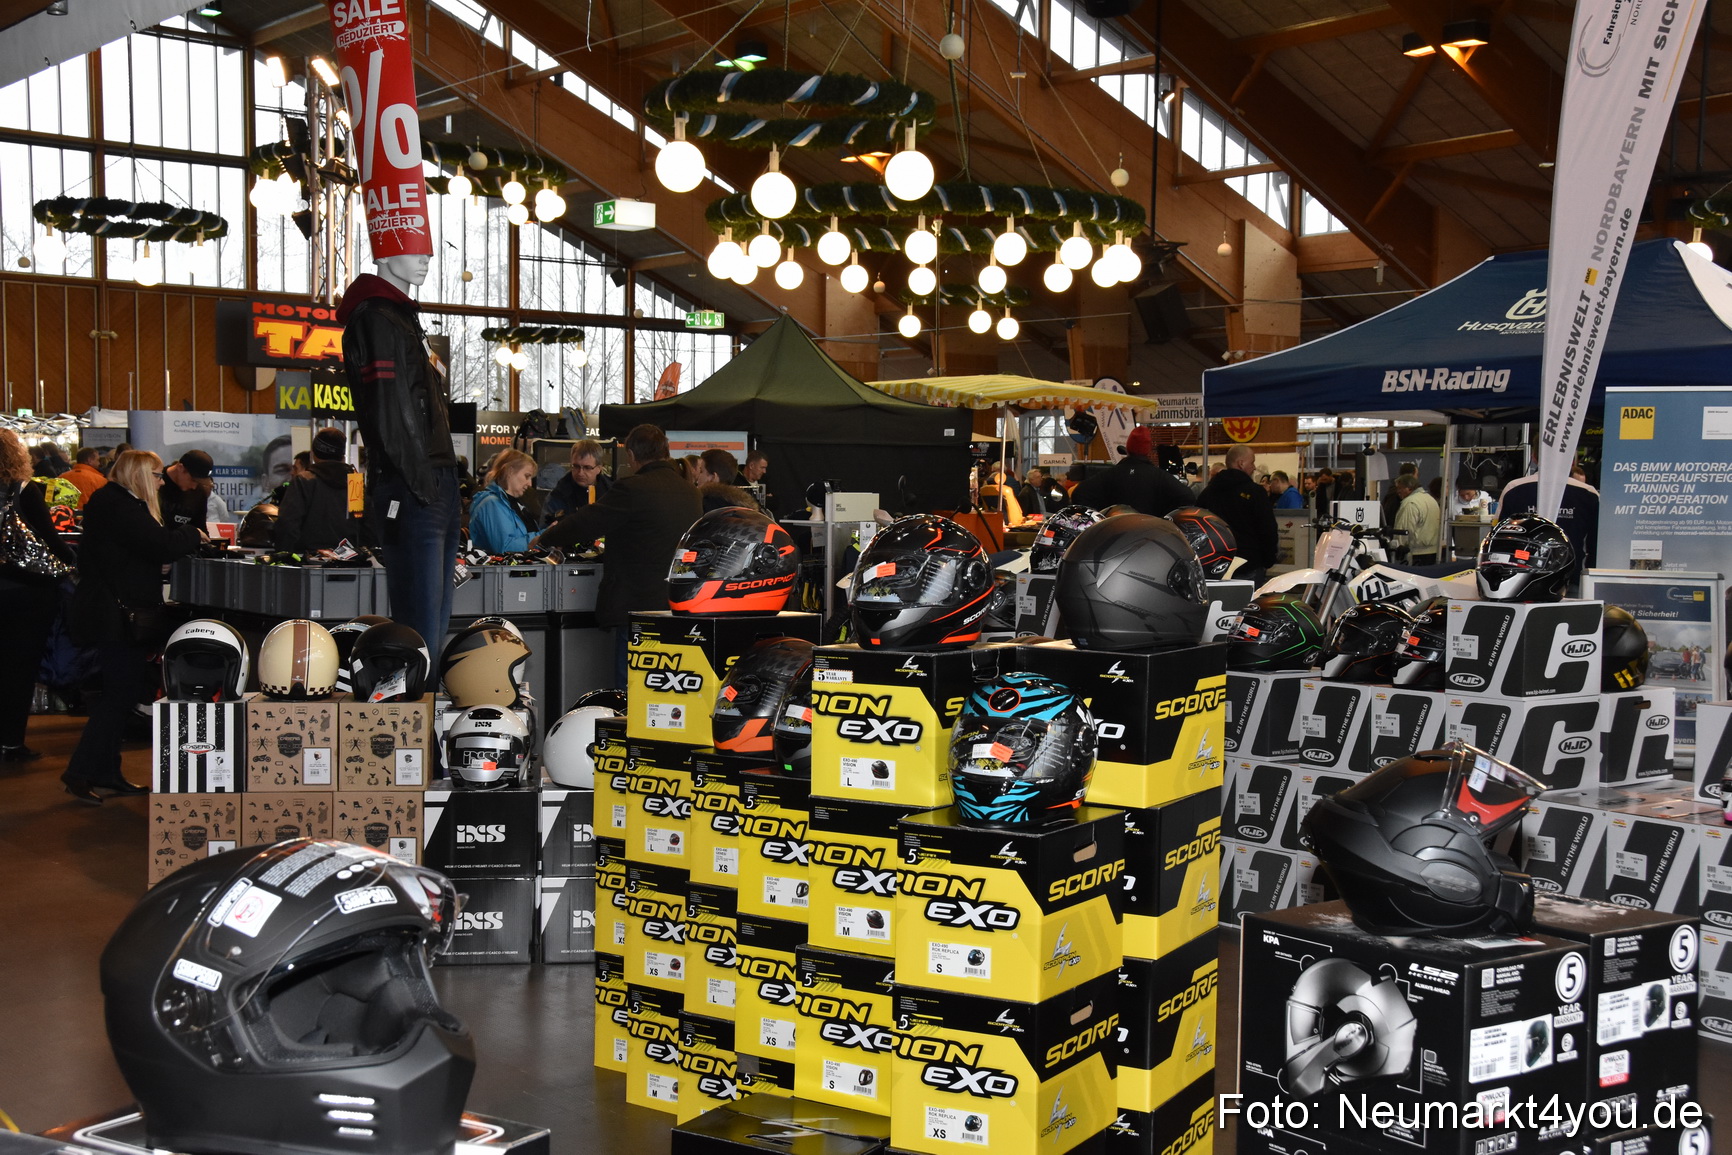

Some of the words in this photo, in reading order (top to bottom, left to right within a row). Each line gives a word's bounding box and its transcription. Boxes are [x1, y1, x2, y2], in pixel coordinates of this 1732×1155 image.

[333, 0, 401, 28] SALE
[338, 22, 397, 45] REDUZIERT
[1542, 290, 1592, 448] ERLEBNISWELT
[1591, 106, 1647, 262] NORDBAYERN
[1637, 57, 1660, 99] MIT
[252, 302, 337, 321] MOTO
[1559, 207, 1632, 454] www.erlebniswelt-bayern.de
[1381, 366, 1511, 393] BSN-Racing
[1157, 397, 1199, 406] Neumarkter
[1622, 408, 1654, 419] ADAC
[173, 420, 201, 428] CARE
[203, 421, 240, 429] VISION
[490, 425, 510, 434] FOR
[233, 468, 249, 476] SEHEN
[1613, 462, 1638, 472] DAS
[1640, 462, 1672, 472] BMW
[1624, 484, 1679, 493] TRAINING
[1682, 484, 1695, 493] IN
[1641, 495, 1728, 504] KOOPERATION
[1615, 505, 1636, 515] MIT
[1639, 505, 1667, 515] DEM
[1669, 505, 1703, 515] ADAC
[724, 572, 797, 591] SCORPIO
[1637, 610, 1679, 618] Sicherheit!
[185, 627, 215, 635] Caberg
[1493, 637, 1501, 651] THE
[1498, 614, 1510, 638] WORLD
[633, 634, 639, 645] 5
[1566, 644, 1591, 654] HJC
[646, 671, 701, 691] EXO
[818, 671, 825, 681] 5
[1455, 675, 1480, 685] HJC
[651, 719, 656, 727] S
[1494, 713, 1507, 734] WORLD
[1648, 717, 1667, 727] HJC
[840, 718, 920, 742] EXO
[601, 739, 607, 750] 5
[1563, 740, 1586, 751] HJC
[1306, 752, 1331, 761] HJC
[629, 758, 635, 769] 5
[696, 775, 703, 786] 5
[846, 777, 853, 787] L
[746, 795, 754, 808] 5
[1242, 826, 1263, 837] HJC
[1567, 842, 1577, 858] THE
[1573, 815, 1588, 844] WORLD
[907, 848, 917, 863] 5
[1656, 857, 1667, 874] THE
[1662, 828, 1678, 859] WORLD
[718, 864, 729, 873] XS
[630, 881, 636, 892] 5
[769, 894, 776, 904] M
[1613, 898, 1646, 909] HJC
[688, 905, 695, 917] 5
[927, 900, 1017, 928] EXO
[644, 921, 685, 942] EX
[842, 927, 850, 936] M
[1263, 935, 1280, 946] KPA
[1679, 935, 1689, 962] 5
[649, 967, 659, 976] XS
[936, 963, 943, 973] S
[1409, 963, 1459, 979] LS2
[601, 971, 607, 981] 5
[804, 973, 812, 986] 5
[1565, 963, 1577, 992] 5
[1671, 973, 1693, 984] YEAR
[1414, 982, 1434, 992] ALWAYS
[1432, 986, 1450, 995] AHEAD
[1670, 983, 1696, 995] WARRANTY
[712, 995, 717, 1004] L
[633, 1002, 639, 1013] 5
[1557, 1002, 1581, 1015] YEAR
[898, 1015, 909, 1030] 5
[1554, 1013, 1583, 1026] WARRANTY
[685, 1034, 692, 1046] 5
[766, 1036, 777, 1046] XS
[618, 1053, 623, 1061] S
[829, 1080, 835, 1090] S
[924, 1066, 1016, 1094] EXO
[651, 1089, 658, 1098] M
[932, 1128, 947, 1139] XS
[1688, 1132, 1699, 1149] 5
